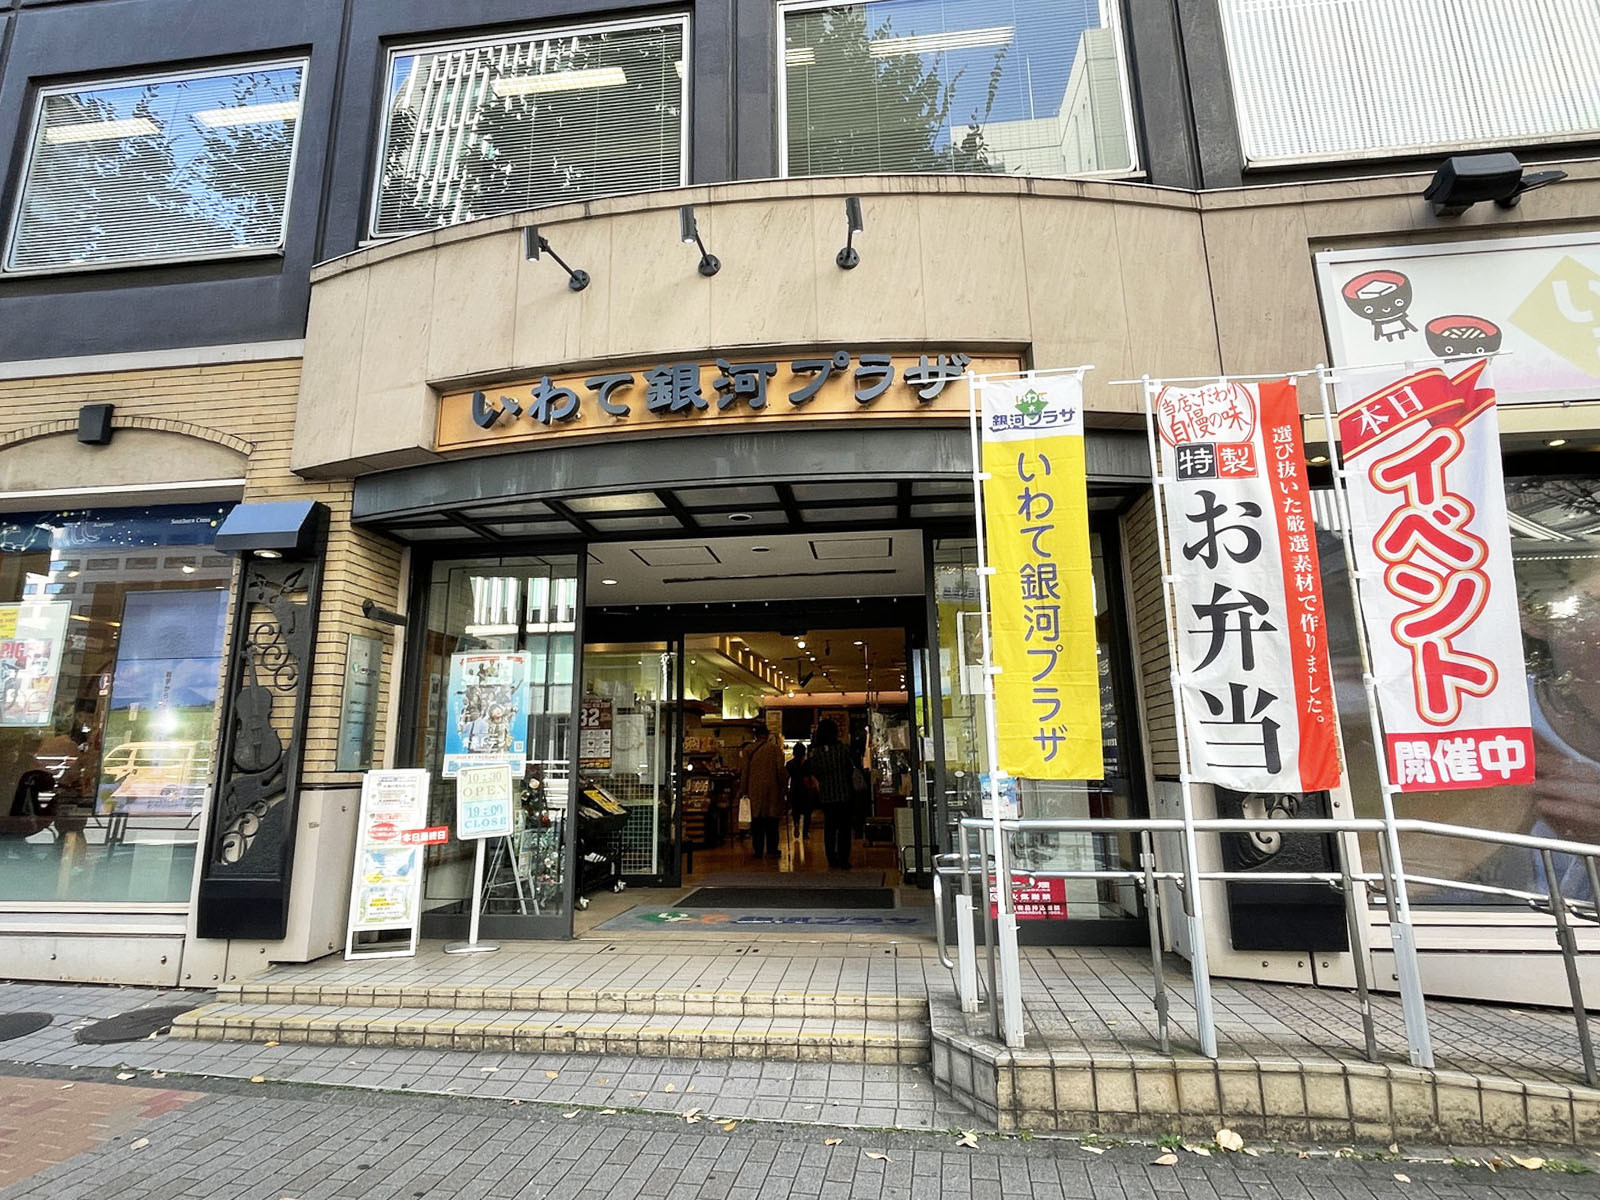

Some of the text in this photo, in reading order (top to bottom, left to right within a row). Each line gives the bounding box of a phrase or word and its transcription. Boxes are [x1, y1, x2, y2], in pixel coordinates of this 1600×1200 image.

[472, 351, 972, 429] いわて銀河プラザ
[1162, 383, 1238, 416] 当店こだわり
[1351, 385, 1424, 438] 本日
[1169, 400, 1252, 443] 自慢の味
[1179, 446, 1256, 476] 特製
[1271, 425, 1325, 724] 選び抜いた厳選素材で作りました。
[1371, 428, 1496, 724] イベント
[1016, 451, 1068, 762] いわて銀河プラザ
[1182, 489, 1281, 775] お弁当
[1395, 734, 1526, 785] 開催中
[463, 785, 507, 797] OPEN
[464, 816, 507, 829] CLOSE
